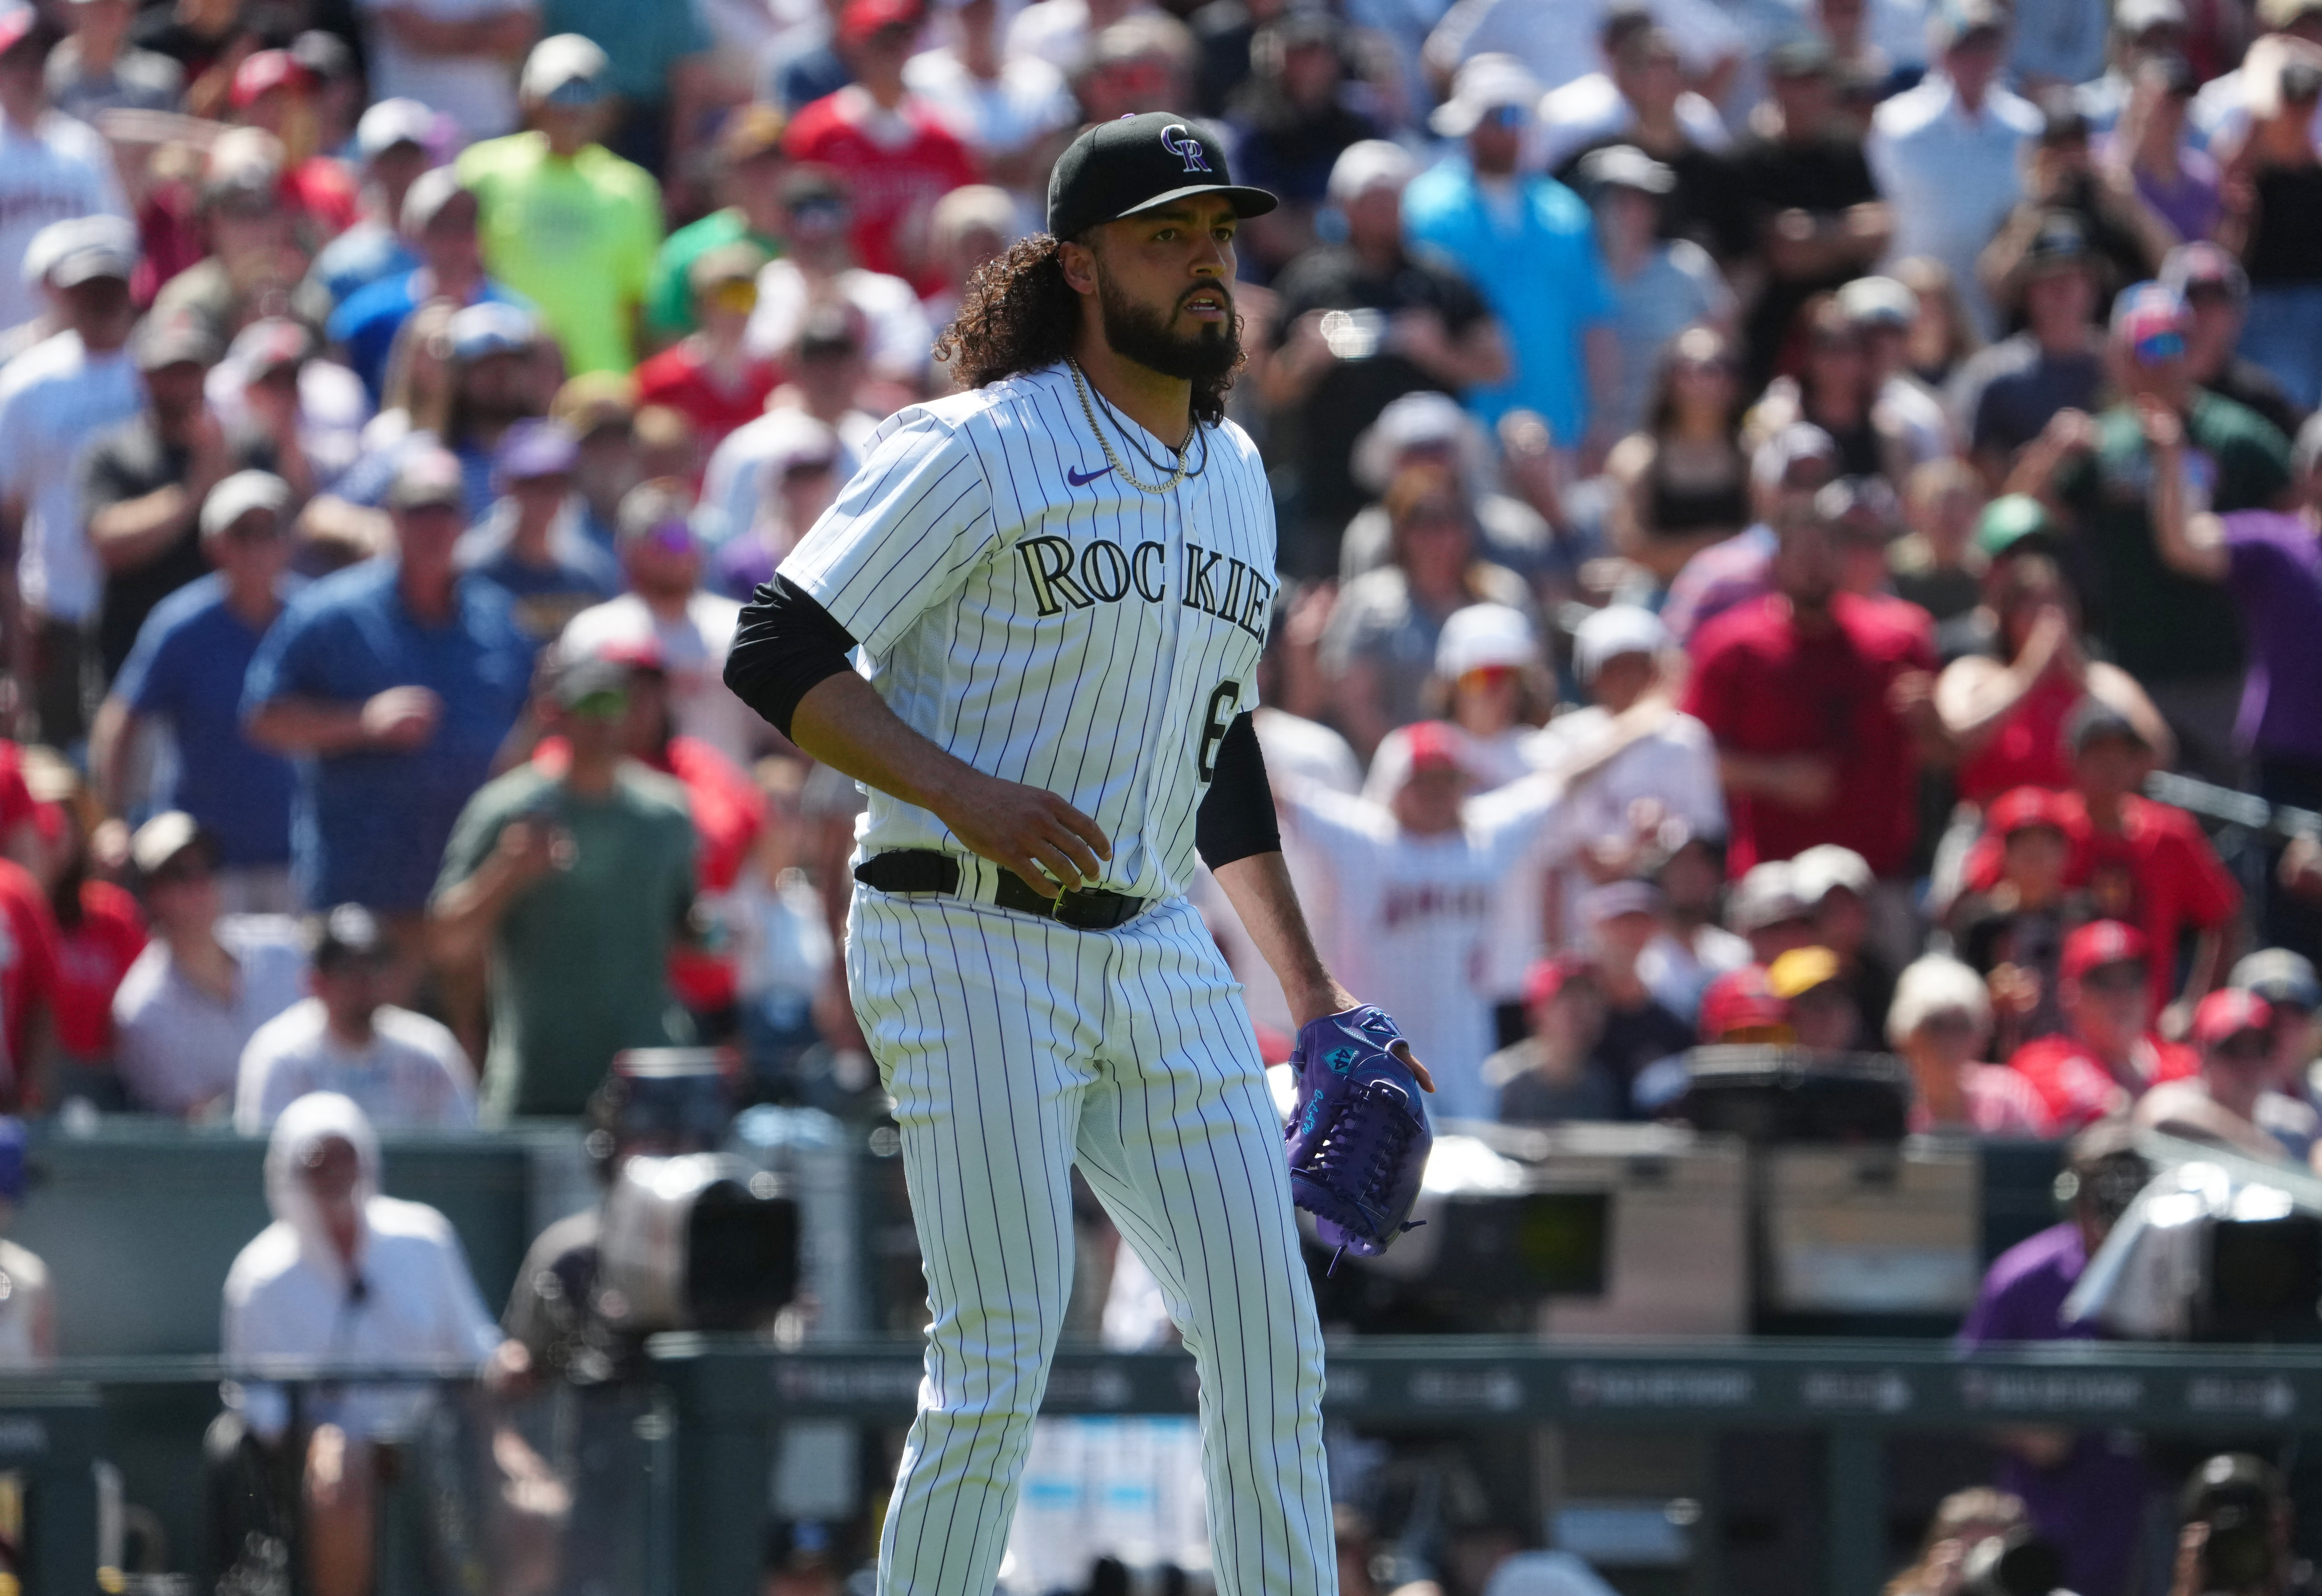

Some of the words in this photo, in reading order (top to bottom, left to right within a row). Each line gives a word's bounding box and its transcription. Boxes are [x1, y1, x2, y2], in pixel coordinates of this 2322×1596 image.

[1161, 124, 1212, 172] CR
[1015, 535, 1279, 651] ROCKIE
[1334, 1049, 1351, 1070] 44
